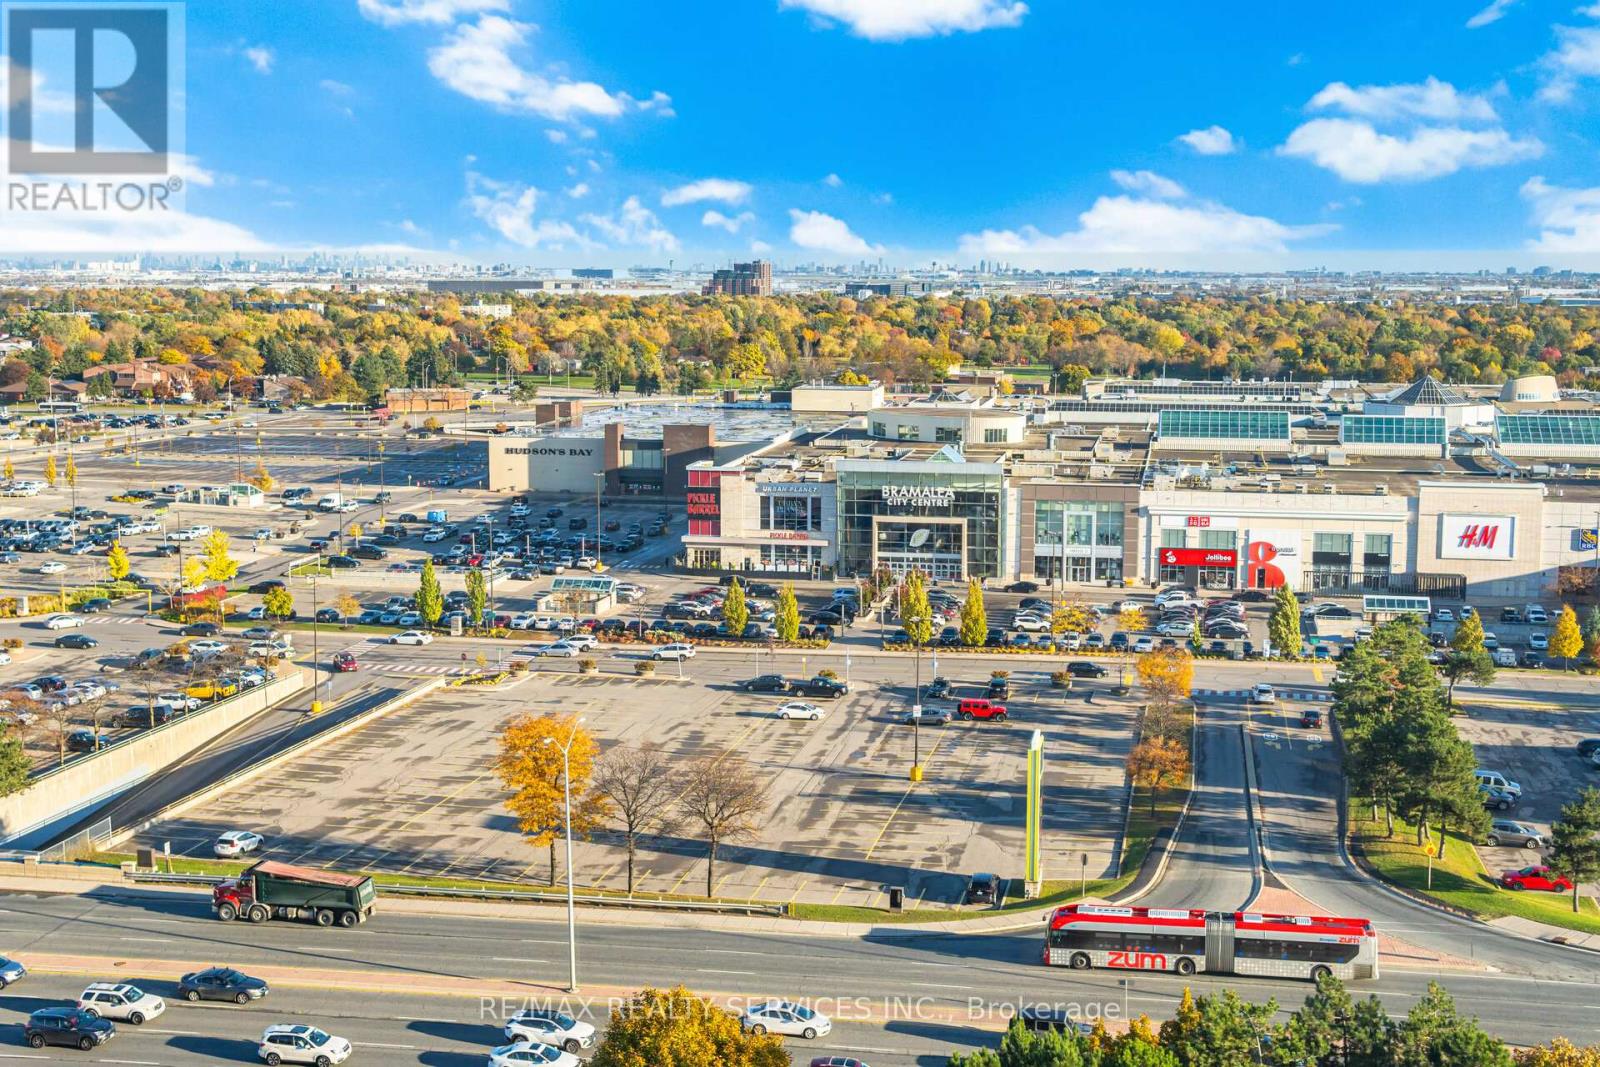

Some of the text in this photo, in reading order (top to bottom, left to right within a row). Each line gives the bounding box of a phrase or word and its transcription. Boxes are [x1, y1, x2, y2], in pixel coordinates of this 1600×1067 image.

[504, 447, 593, 456] HUDSON'S BAY
[881, 485, 955, 499] BRAMALEA
[887, 498, 949, 507] CITY CENTRE
[1458, 524, 1499, 549] H&M
